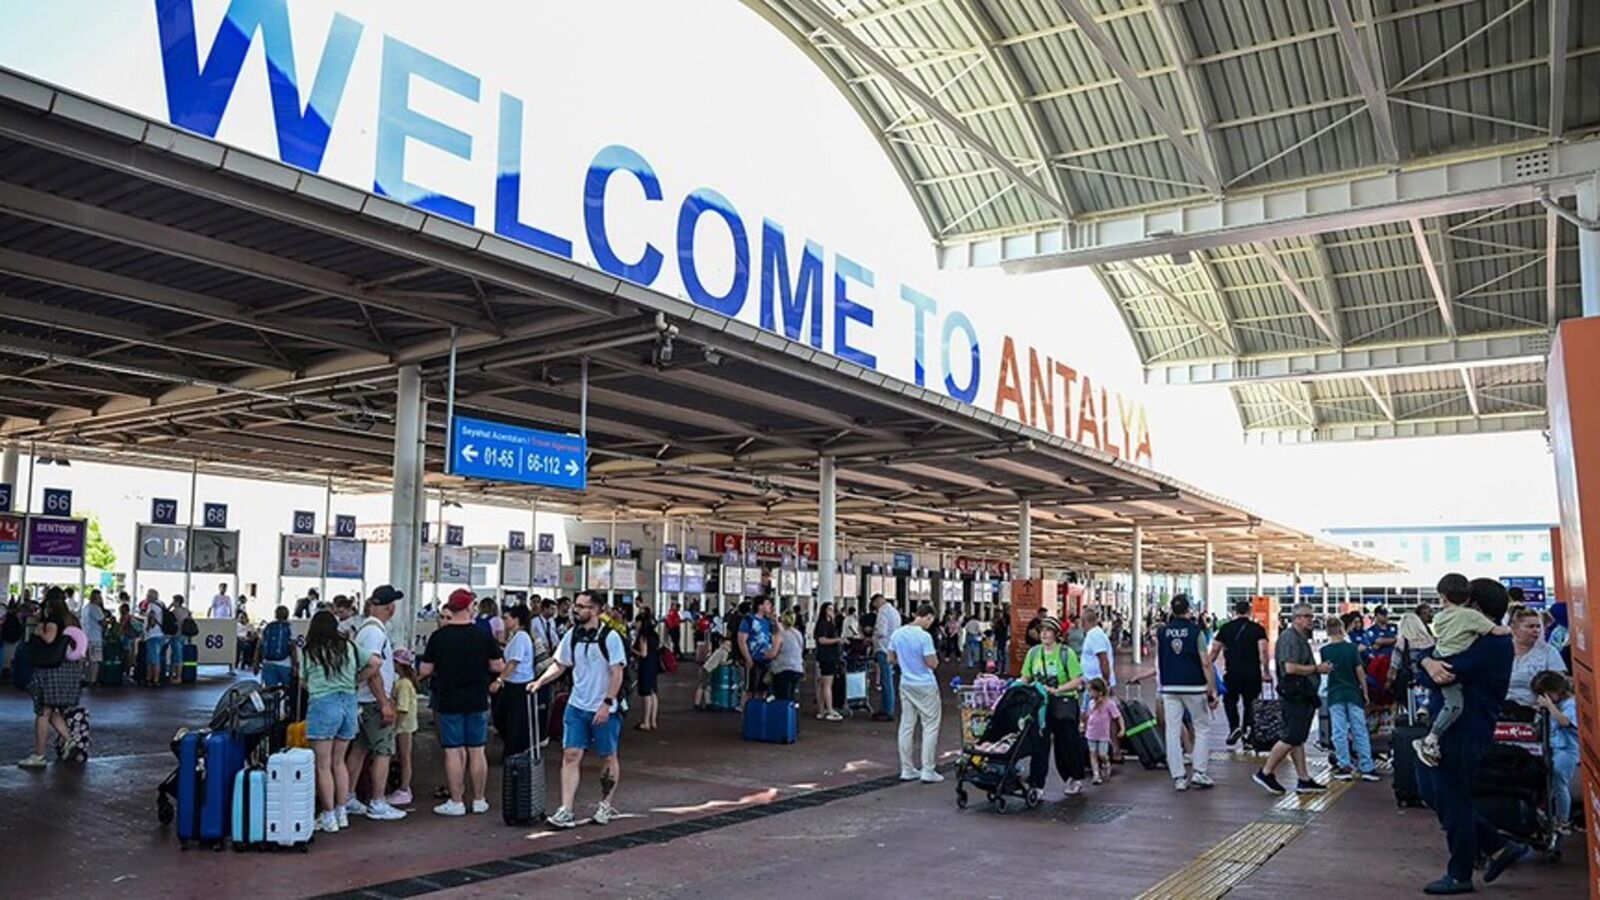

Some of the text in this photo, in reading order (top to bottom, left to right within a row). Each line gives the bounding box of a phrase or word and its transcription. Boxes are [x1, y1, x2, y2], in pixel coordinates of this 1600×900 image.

[155, 0, 1152, 468] WELCOME TO ANTALYA
[484, 447, 514, 468] 01-65
[527, 453, 560, 475] 66-112
[0, 489, 8, 506] 5
[47, 494, 69, 510] 66
[155, 503, 175, 518] 67
[207, 508, 225, 522] 68
[37, 523, 77, 534] BENTOUR
[296, 515, 313, 530] 69
[339, 519, 354, 533] 70
[450, 528, 463, 542] 72
[512, 534, 525, 546] 73
[541, 536, 553, 548] 74
[143, 537, 186, 558] CIP
[205, 634, 224, 649] 68
[415, 634, 427, 647] 71
